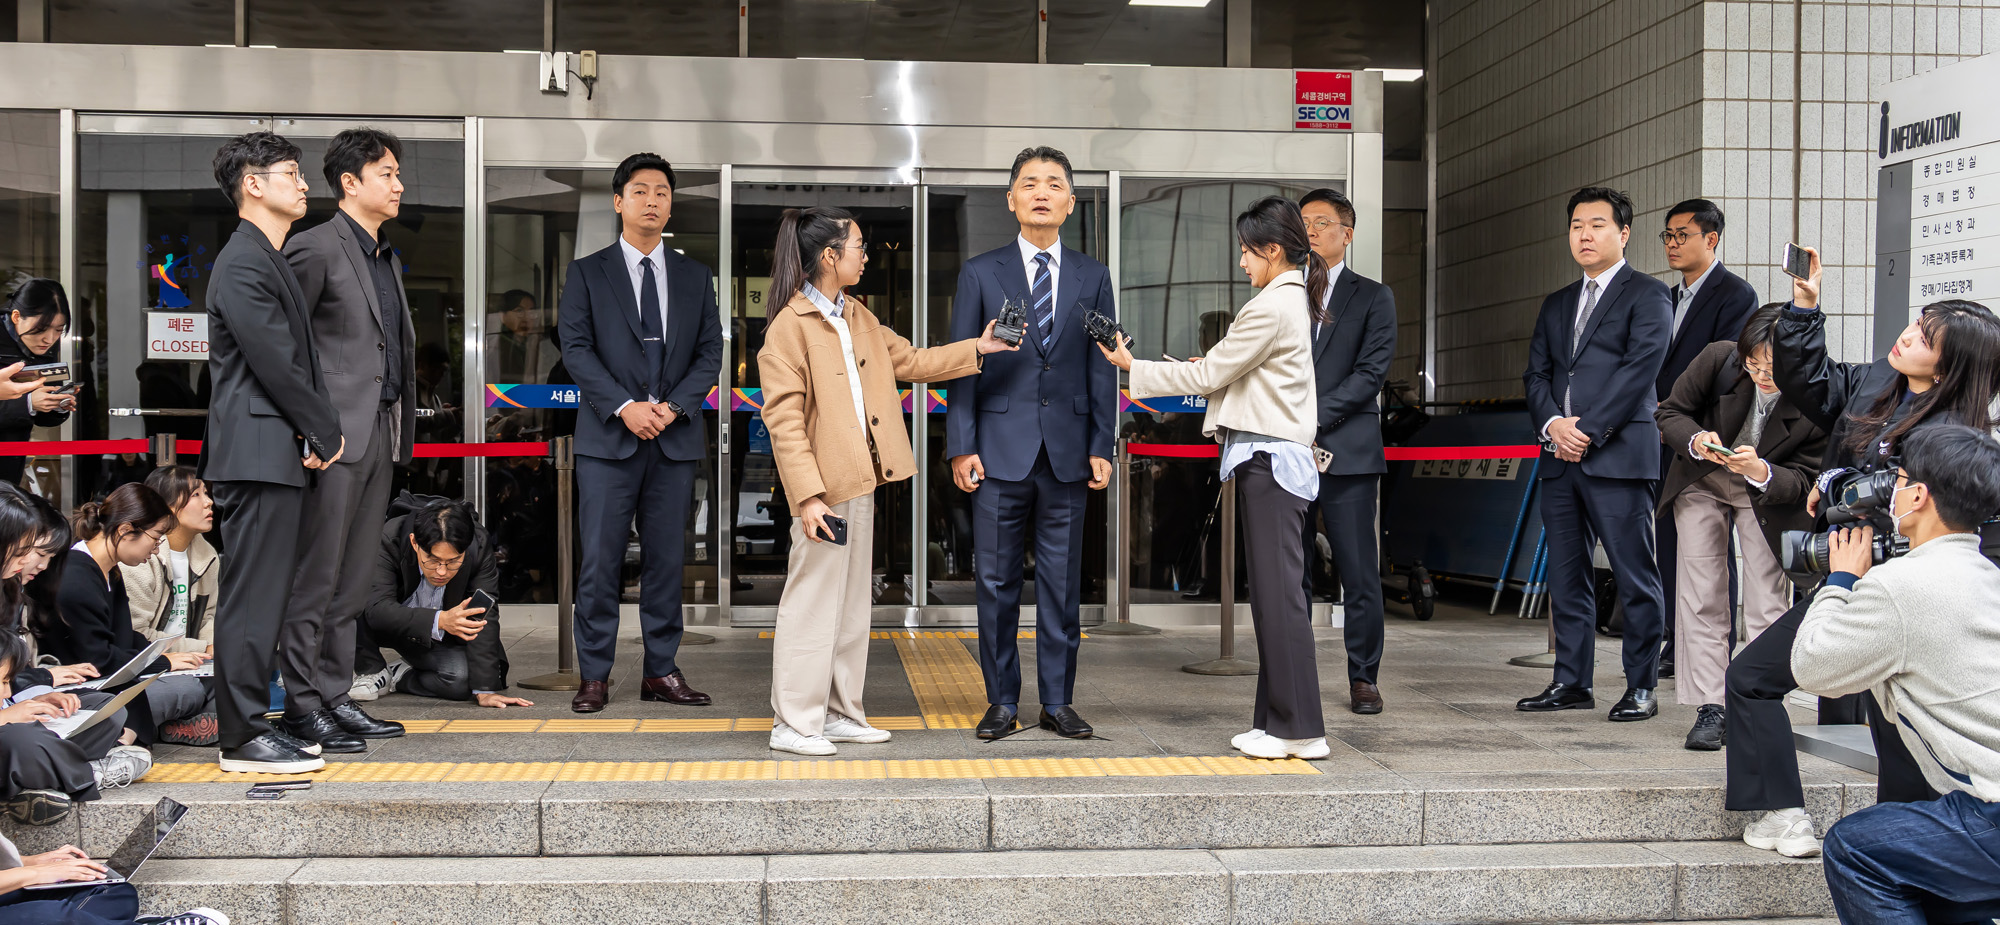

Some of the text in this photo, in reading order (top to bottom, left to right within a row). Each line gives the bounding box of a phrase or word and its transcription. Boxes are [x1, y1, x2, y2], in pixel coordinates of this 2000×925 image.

[1298, 106, 1349, 120] SECOM
[1890, 111, 1962, 153] INFORMATION
[1889, 171, 1893, 188] 1
[1921, 248, 1974, 267] 가족관계등록계
[1888, 258, 1895, 276] 2
[1921, 278, 1973, 297] 경매/기타집행계
[167, 318, 195, 332] 폐문
[151, 339, 209, 353] CLOSED
